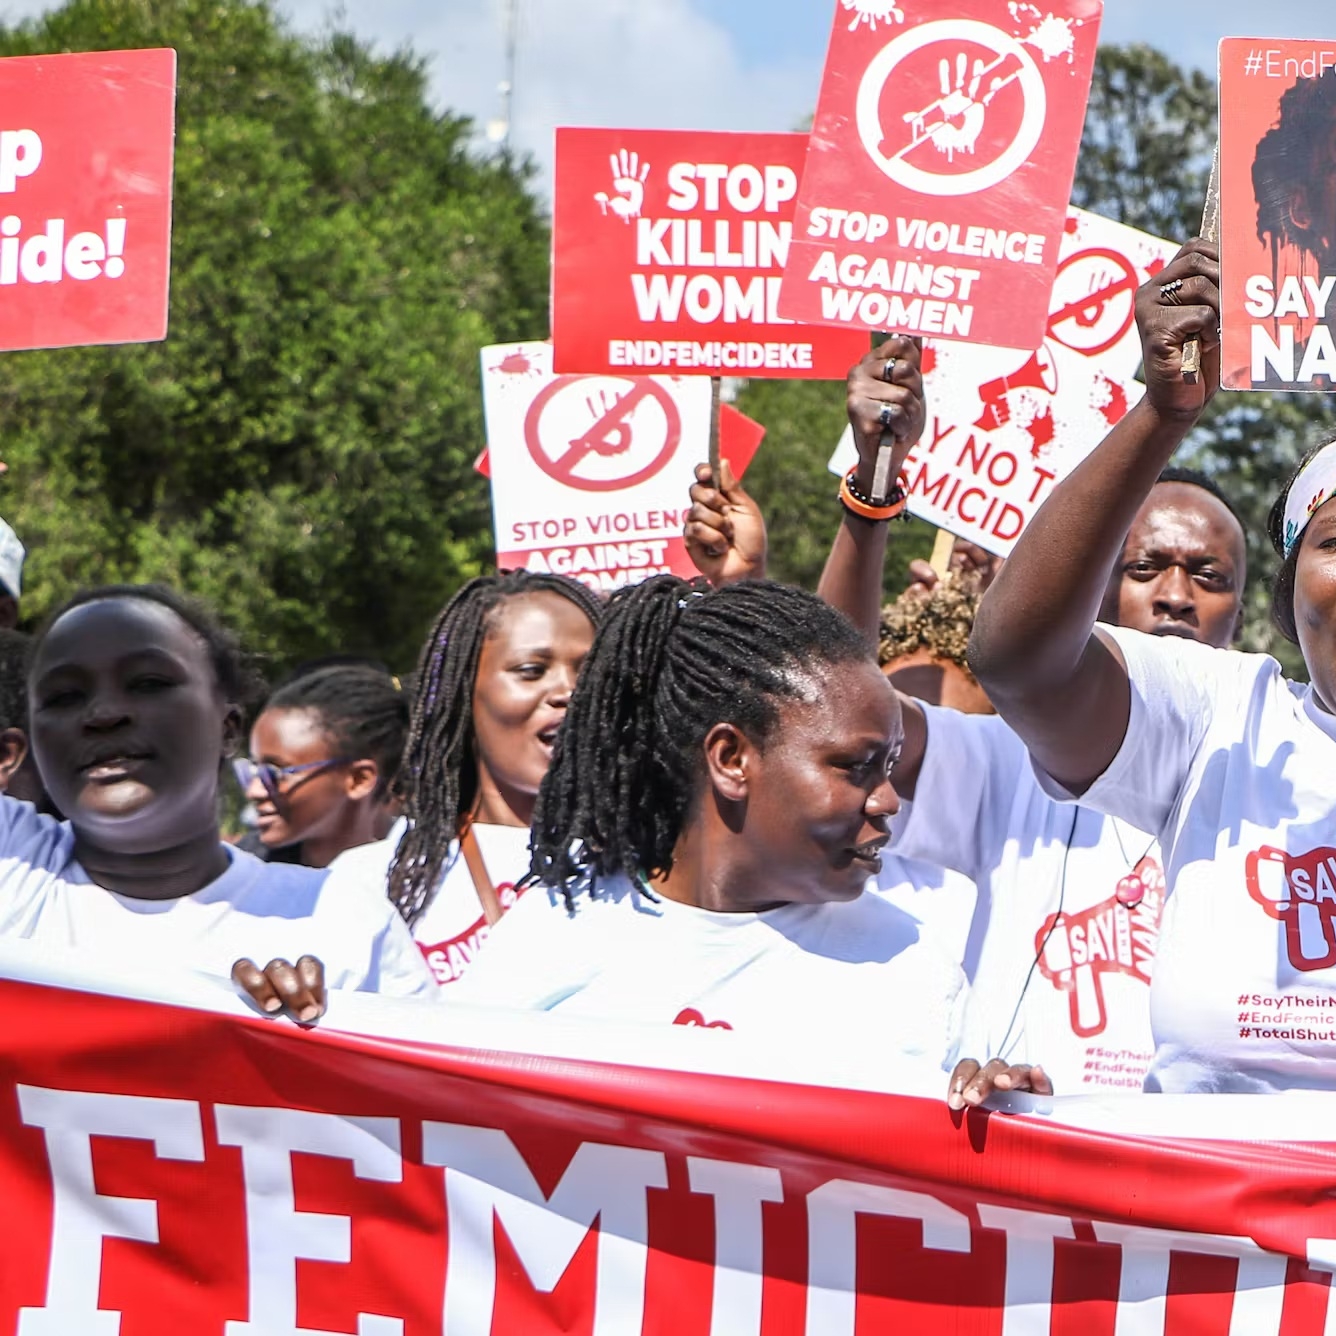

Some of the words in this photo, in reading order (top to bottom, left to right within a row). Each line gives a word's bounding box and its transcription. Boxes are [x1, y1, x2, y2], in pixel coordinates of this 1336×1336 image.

[667, 162, 797, 213] STOP
[0, 215, 127, 284] ide!
[637, 218, 793, 268] KILLIN
[807, 207, 889, 243] STOP
[896, 217, 1046, 265] VIOLENCE
[630, 274, 808, 324] WOM
[808, 251, 980, 301] AGAINST
[1244, 275, 1336, 319] SAY
[820, 286, 974, 337] WOMEN
[608, 340, 813, 368] ENDFEMICIDEKE
[956, 434, 1018, 487] NO
[1028, 466, 1056, 502] T
[512, 518, 577, 541] STOP
[587, 509, 692, 535] VIOLEN
[524, 539, 668, 576] AGAINST
[1070, 908, 1116, 965] SAY
[1084, 1061, 1147, 1075] #EndFemi
[1086, 1048, 1155, 1061] #SayTheir
[1083, 1075, 1142, 1088] #TotalSh
